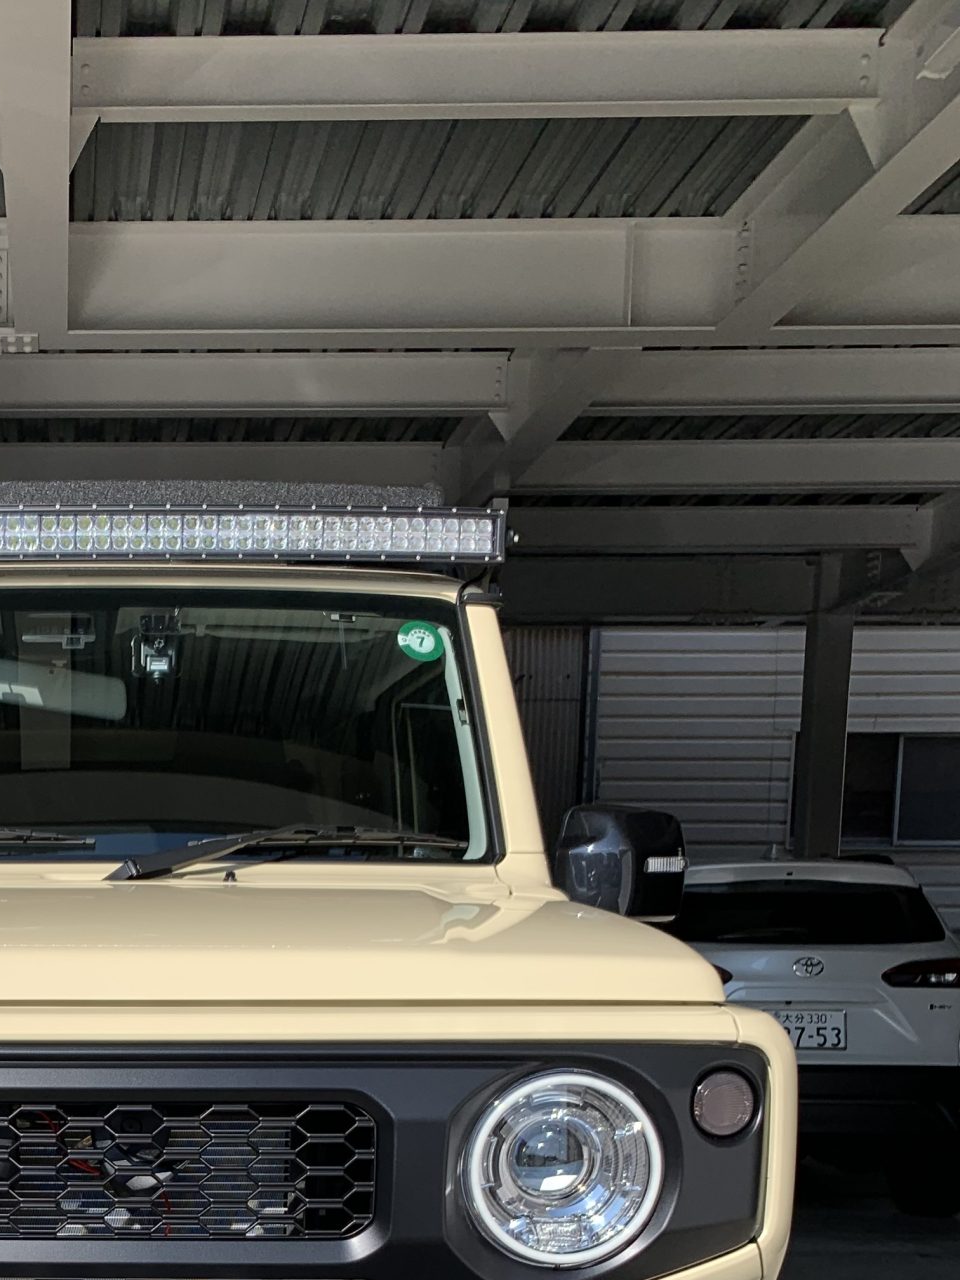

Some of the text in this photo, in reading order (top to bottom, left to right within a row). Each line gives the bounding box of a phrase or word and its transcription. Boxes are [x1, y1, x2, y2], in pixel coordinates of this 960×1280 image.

[416, 636, 425, 648] 7
[782, 1013, 827, 1024] 大分 330
[784, 1026, 842, 1047] 7-53
